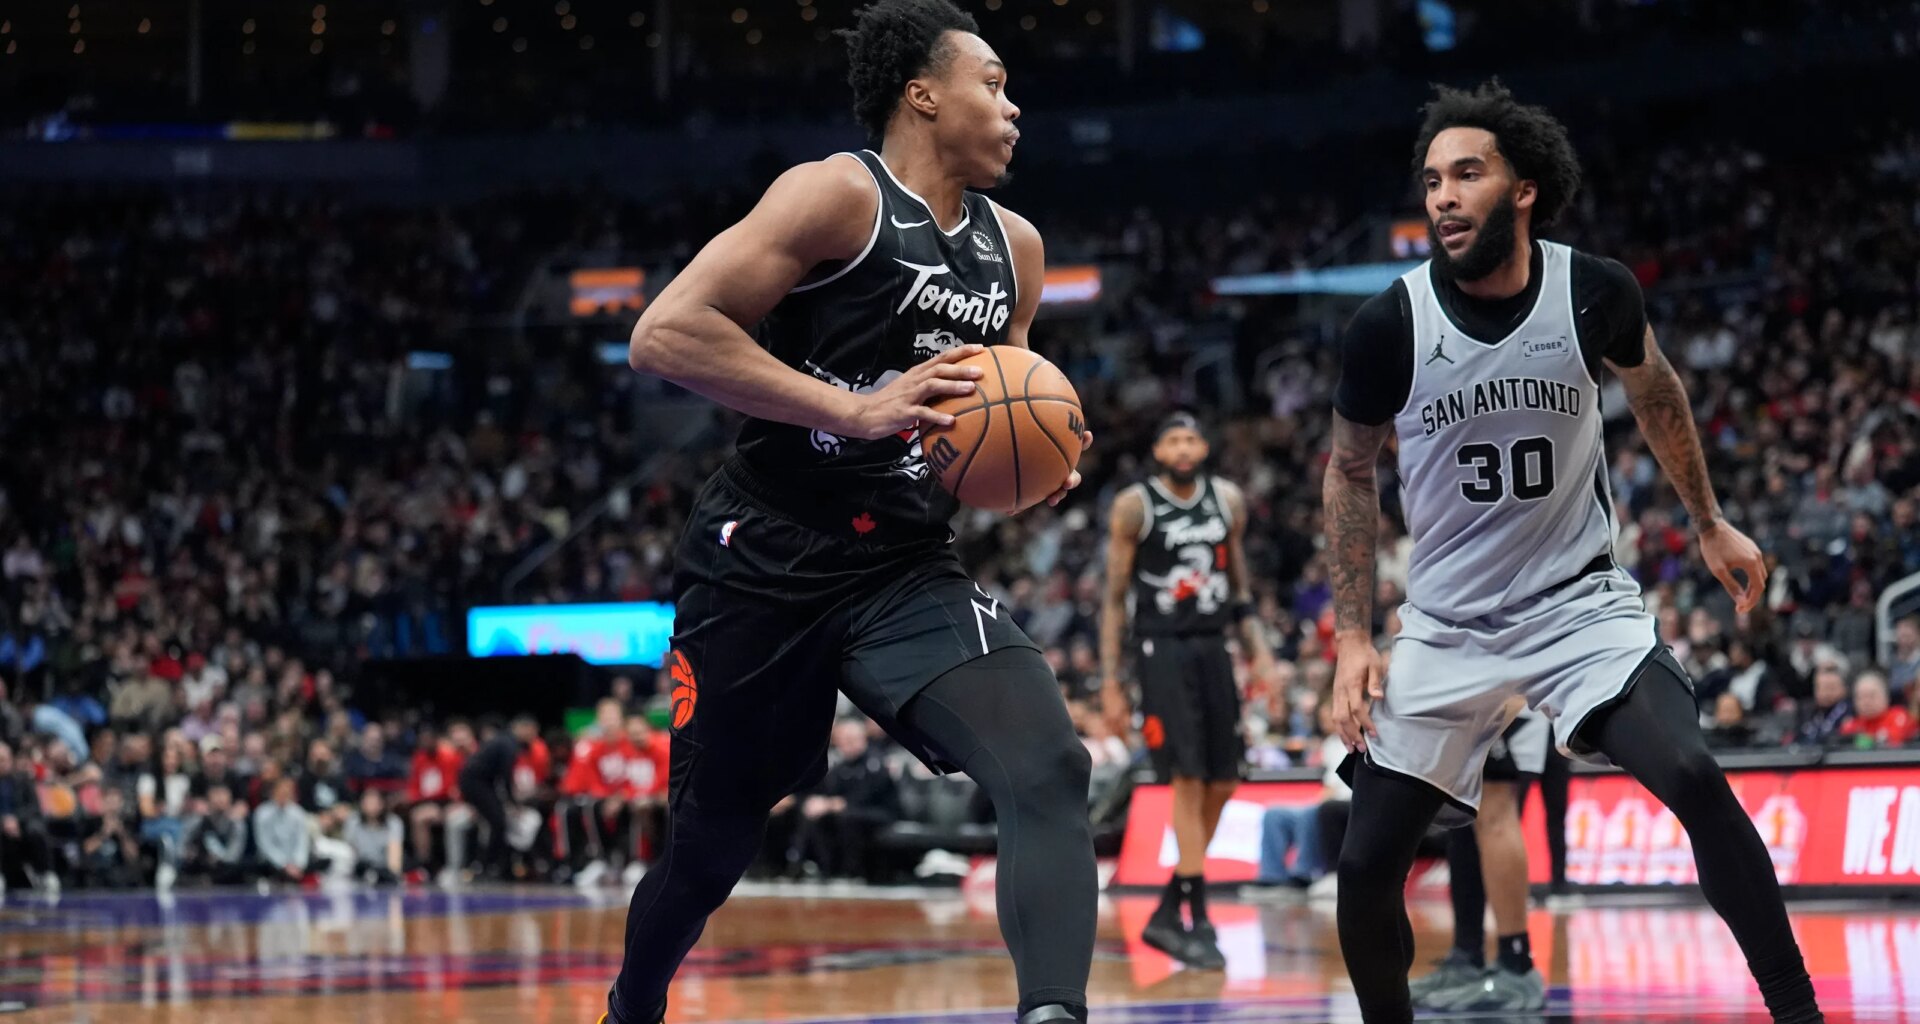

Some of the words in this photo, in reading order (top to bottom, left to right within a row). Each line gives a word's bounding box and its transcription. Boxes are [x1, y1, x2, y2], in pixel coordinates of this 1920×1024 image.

[976, 251, 991, 261] Sun
[990, 253, 1004, 264] Life
[892, 257, 1010, 336] Toronto
[1528, 341, 1563, 352] LEDGER
[1421, 388, 1467, 438] SAN
[1472, 376, 1581, 418] ANTONIO
[1456, 435, 1556, 505] 30
[1842, 786, 1898, 875] WE
